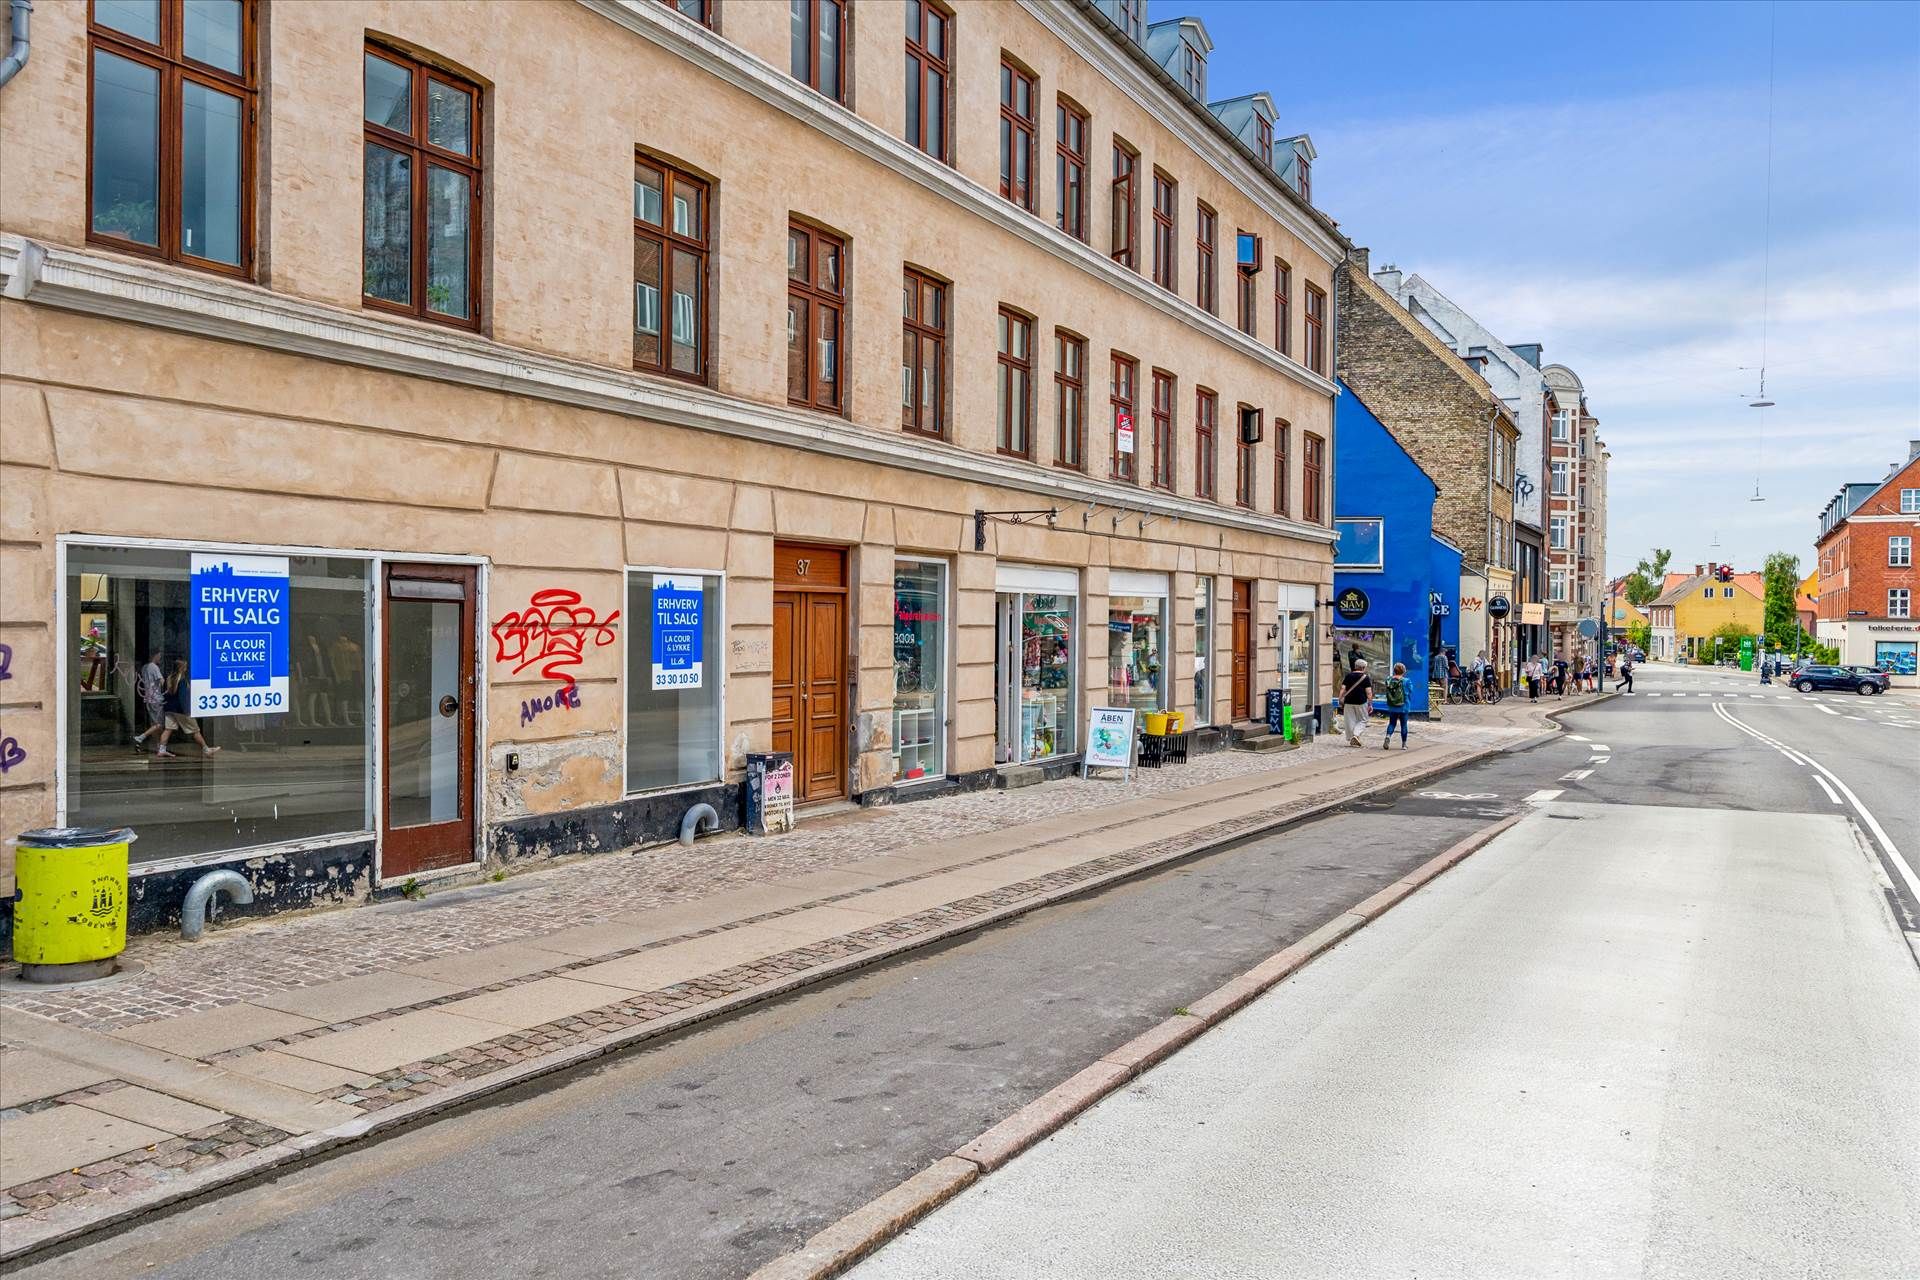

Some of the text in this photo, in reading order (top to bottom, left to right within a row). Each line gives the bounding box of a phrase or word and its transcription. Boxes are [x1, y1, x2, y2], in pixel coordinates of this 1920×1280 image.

[797, 560, 811, 575] 37
[202, 587, 280, 603] ERHVERV
[658, 598, 698, 610] ERHVERV
[1340, 600, 1364, 608] SIAM
[200, 608, 280, 625] TIL SALG
[657, 612, 698, 625] TIL SALG
[216, 640, 266, 650] LA COUR
[667, 644, 690, 652] & LYKKE
[220, 652, 266, 662] & LYKKE
[228, 670, 254, 682] LL.dk
[656, 673, 698, 684] 33 30 10 50
[198, 692, 282, 710] 33 30 10 50
